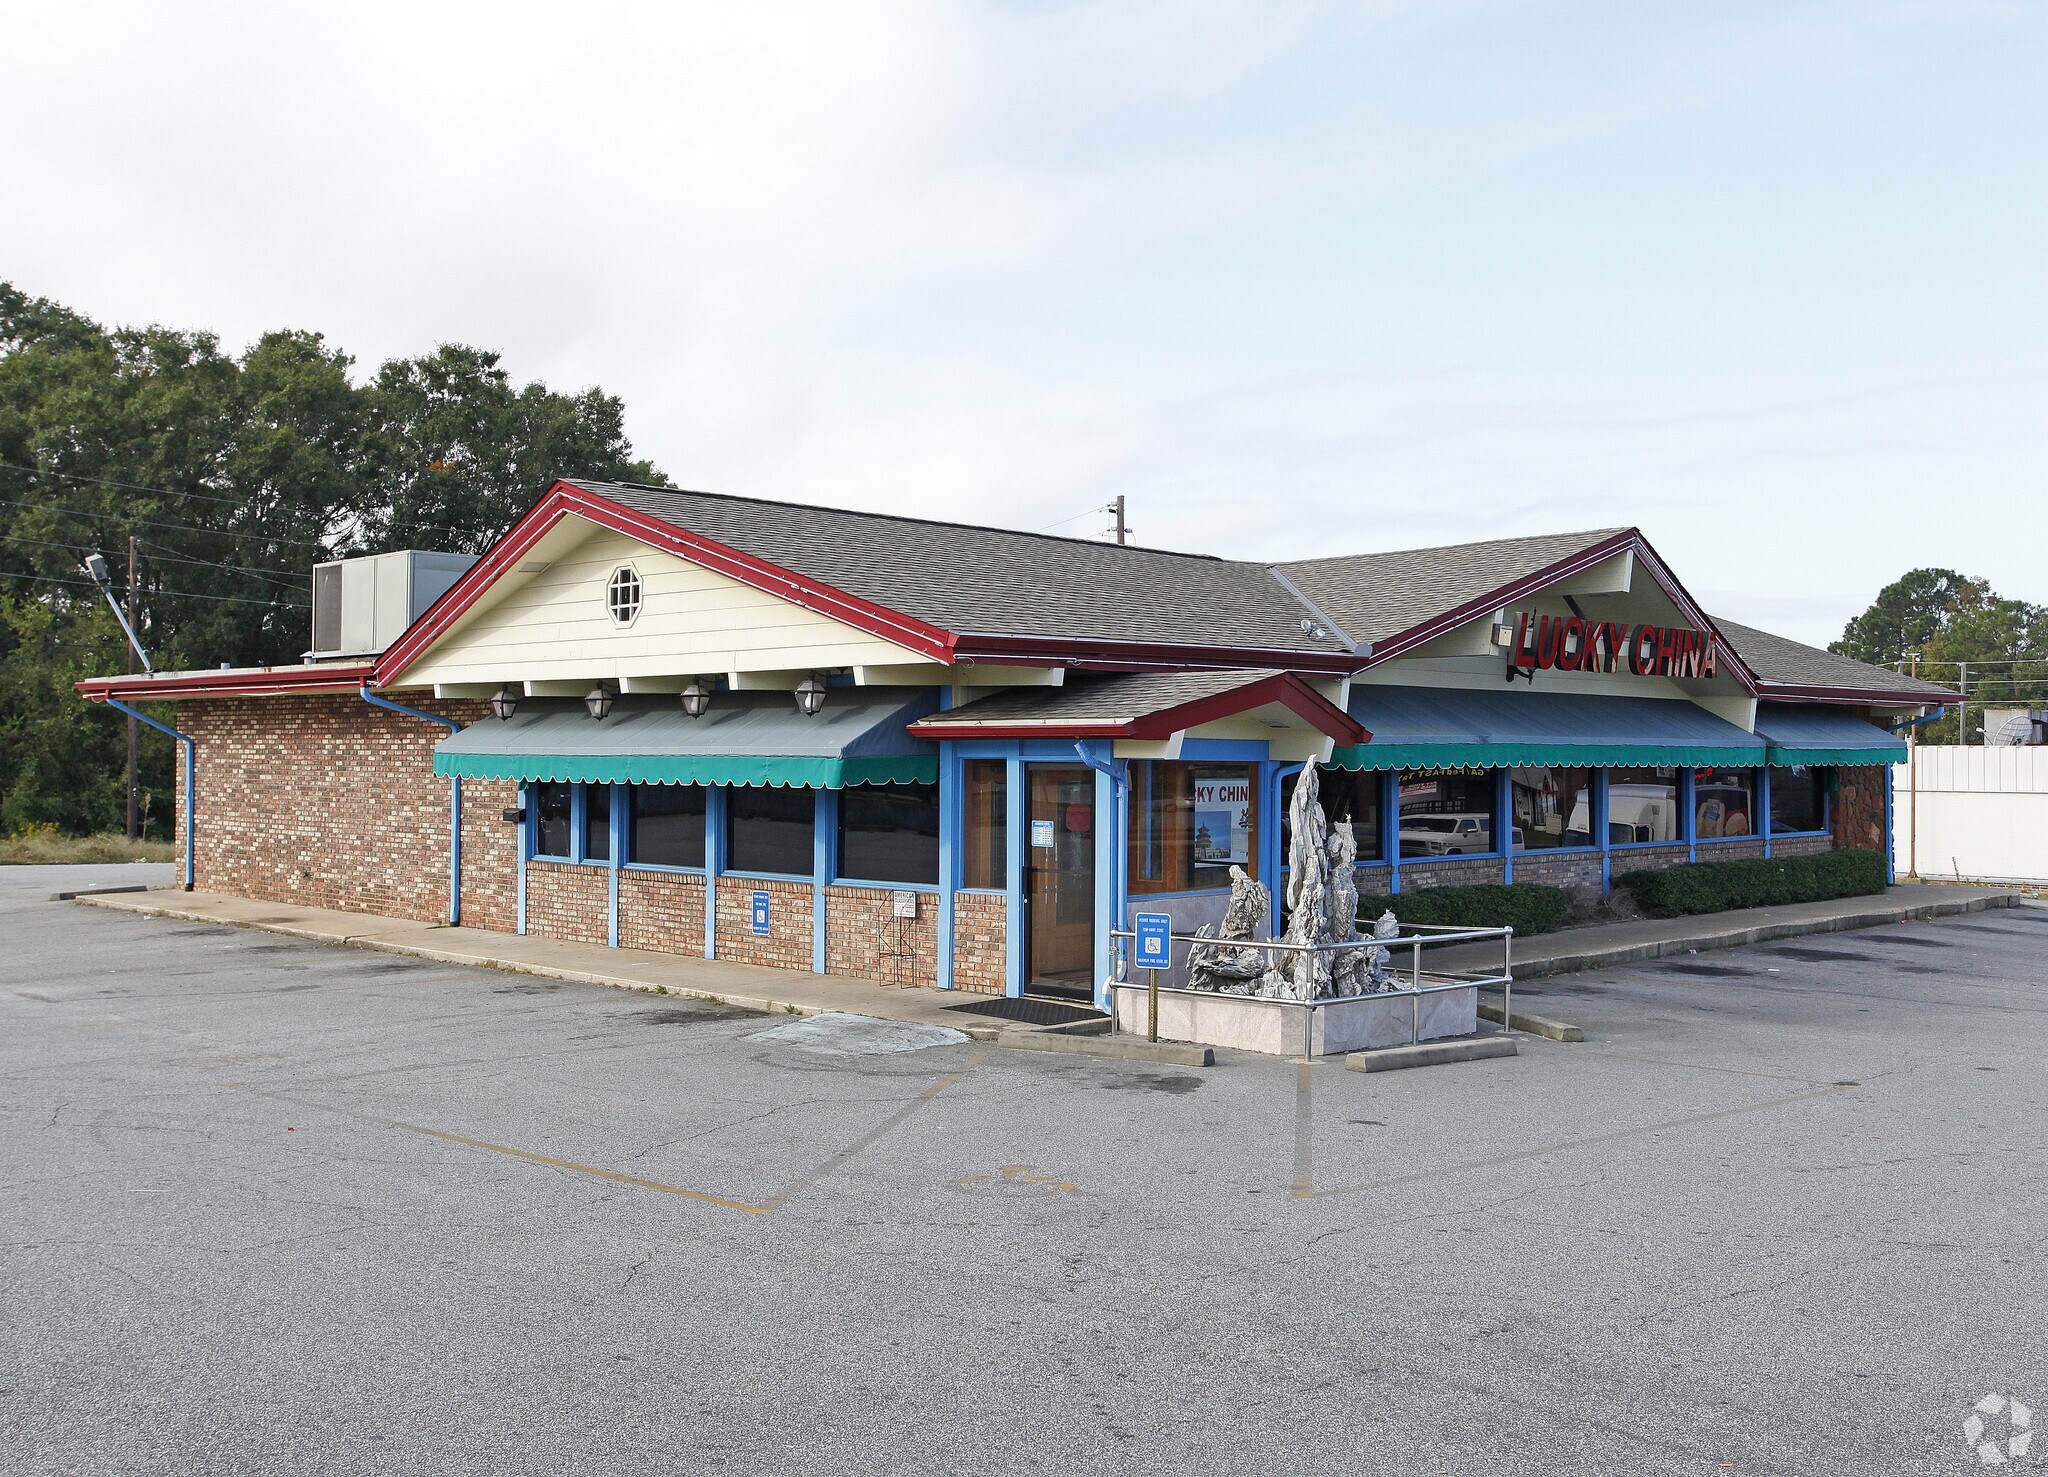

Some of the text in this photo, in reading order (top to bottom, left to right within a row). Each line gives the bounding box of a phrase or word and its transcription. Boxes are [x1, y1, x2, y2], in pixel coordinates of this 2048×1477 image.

[1514, 612, 1717, 679] LUCKY CHINA
[1194, 786, 1215, 802] KY
